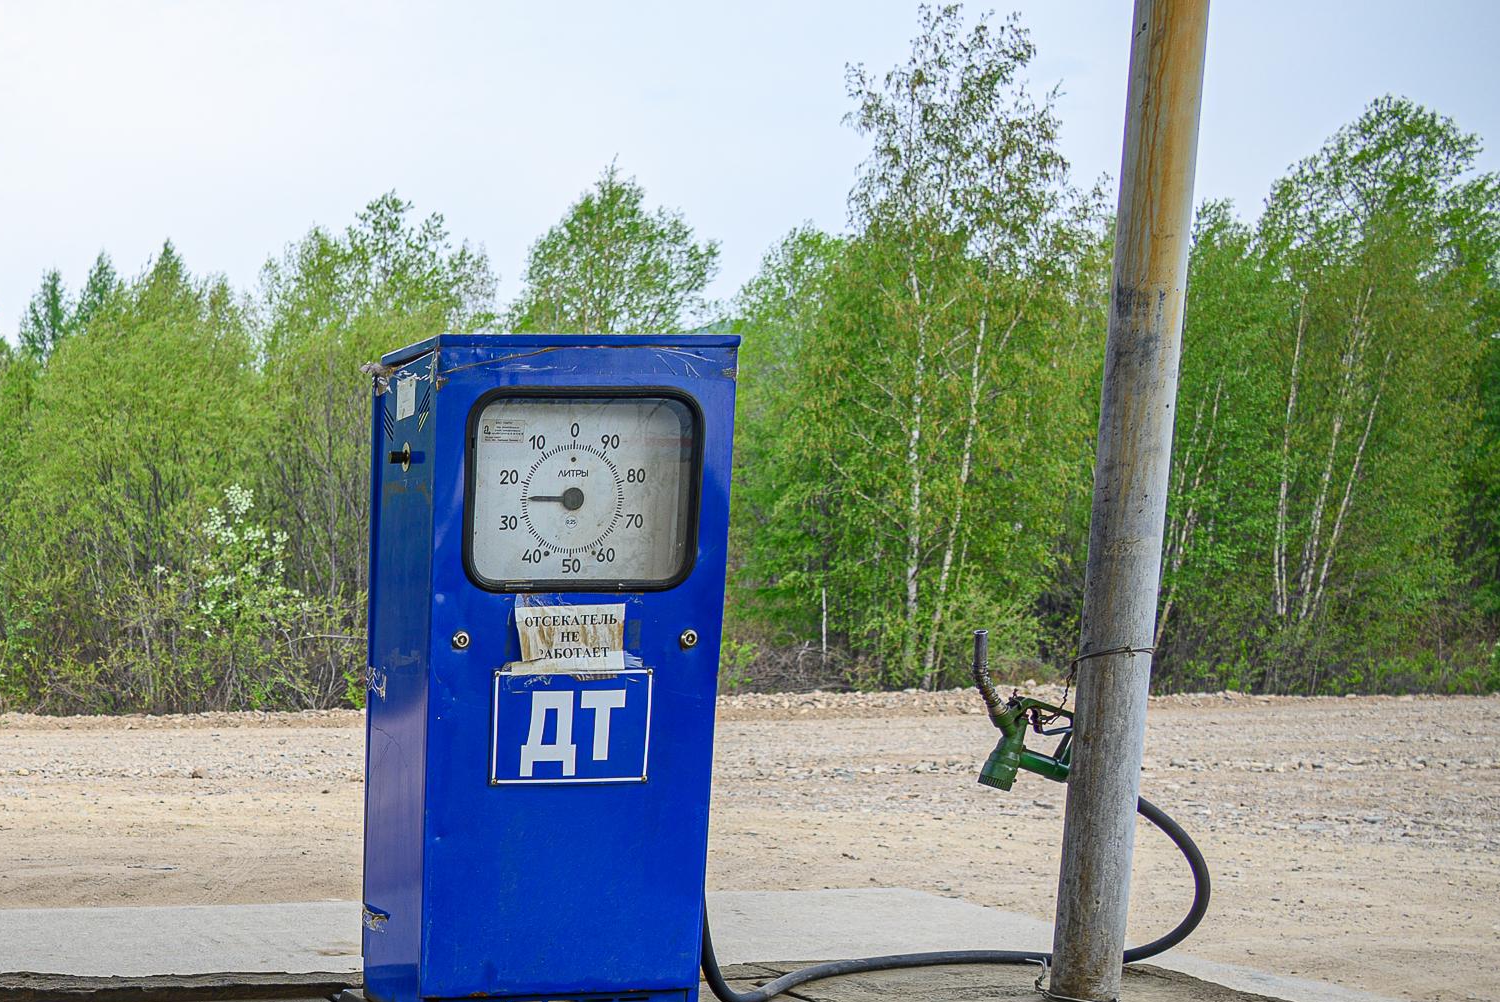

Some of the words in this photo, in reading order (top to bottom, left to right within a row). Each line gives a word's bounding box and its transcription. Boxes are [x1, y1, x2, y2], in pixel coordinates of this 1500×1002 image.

[570, 422, 580, 438] 0
[528, 434, 546, 450] 10
[601, 434, 620, 449] 90
[499, 469, 519, 485] 20
[557, 469, 589, 478] ЛИТРЫ
[626, 468, 646, 483] 80
[498, 515, 518, 530] 30
[625, 513, 643, 529] 70
[521, 549, 542, 564] 40
[596, 547, 616, 563] 60
[561, 558, 581, 574] 50
[524, 613, 618, 628] ОТСЕКАТЕЛЬ
[560, 631, 580, 643] НЕ
[519, 689, 627, 777] ДТ
